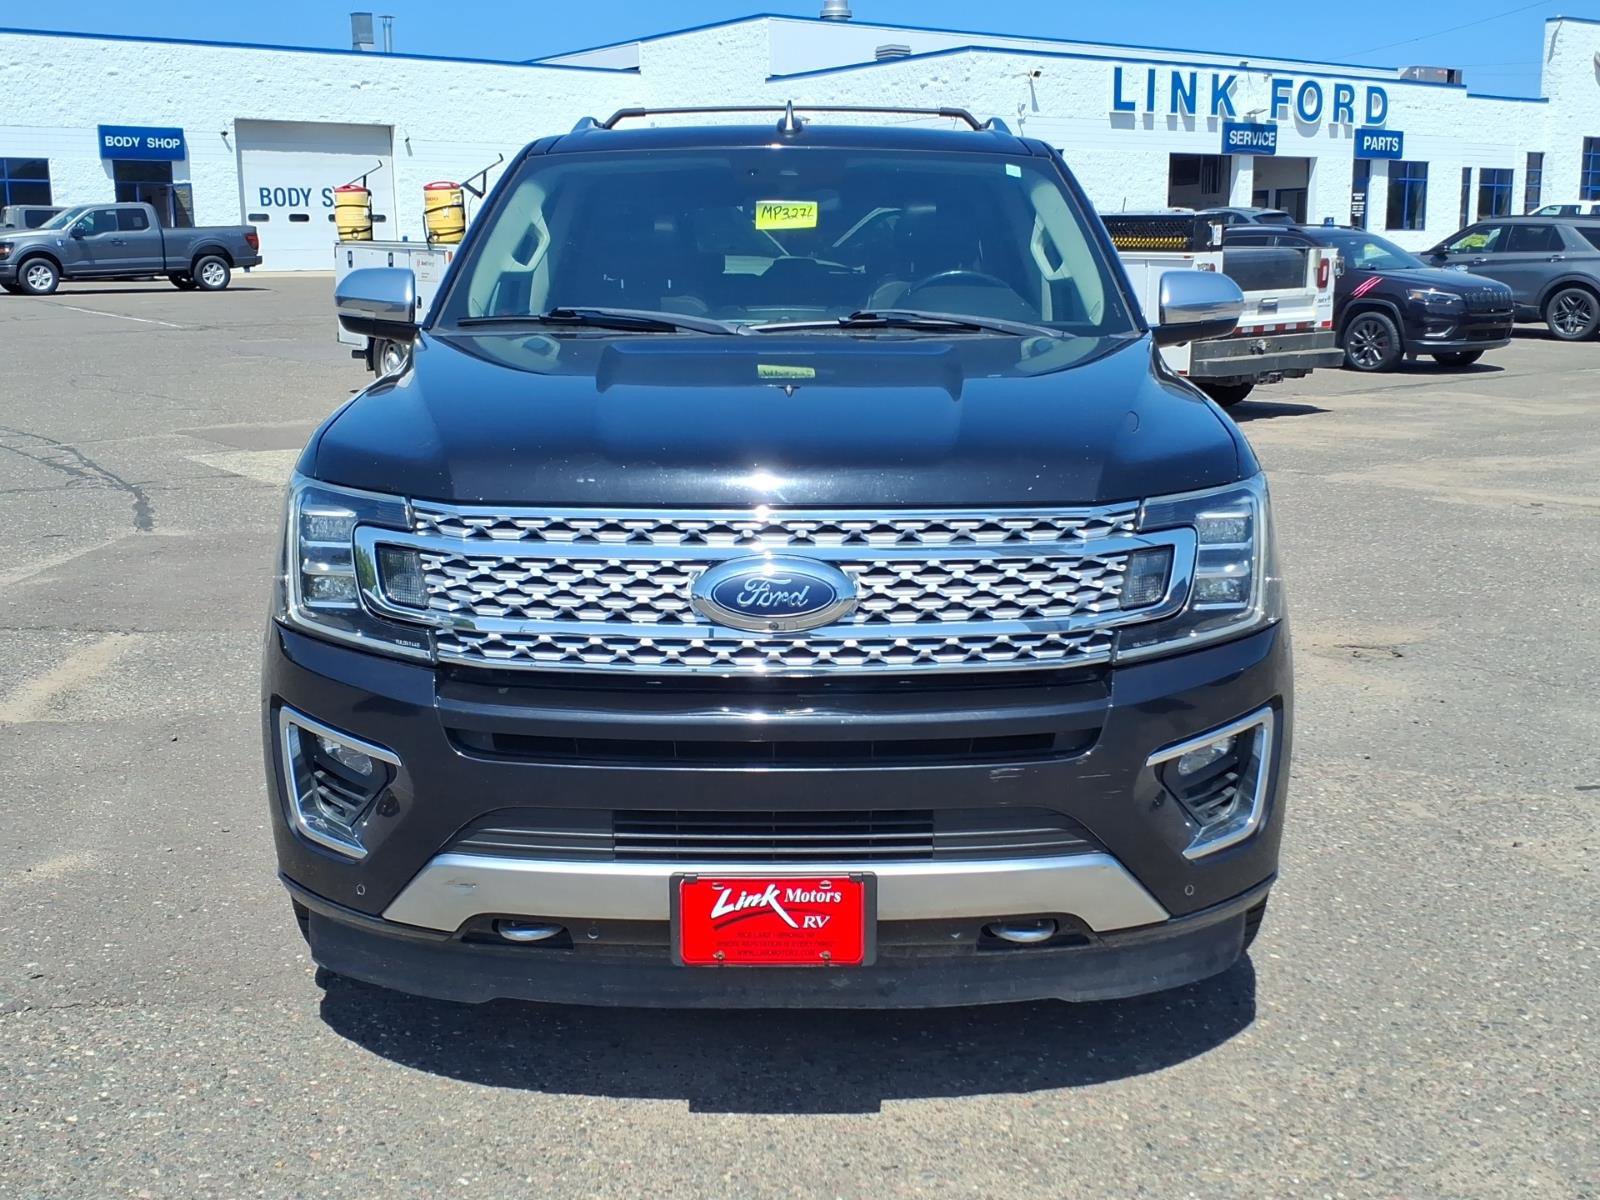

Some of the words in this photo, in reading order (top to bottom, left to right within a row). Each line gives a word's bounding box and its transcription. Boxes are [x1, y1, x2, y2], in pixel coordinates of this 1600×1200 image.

[1113, 66, 1237, 117] LINK
[1270, 78, 1388, 124] FORD
[104, 135, 140, 148] BODY
[146, 137, 181, 149] SHOP
[1229, 130, 1276, 147] SERVICE
[1363, 135, 1399, 151] PARTS
[259, 187, 312, 207] BODY
[737, 576, 810, 607] Ford
[711, 883, 799, 929] Link
[784, 888, 842, 903] Motors
[802, 915, 830, 929] RV
